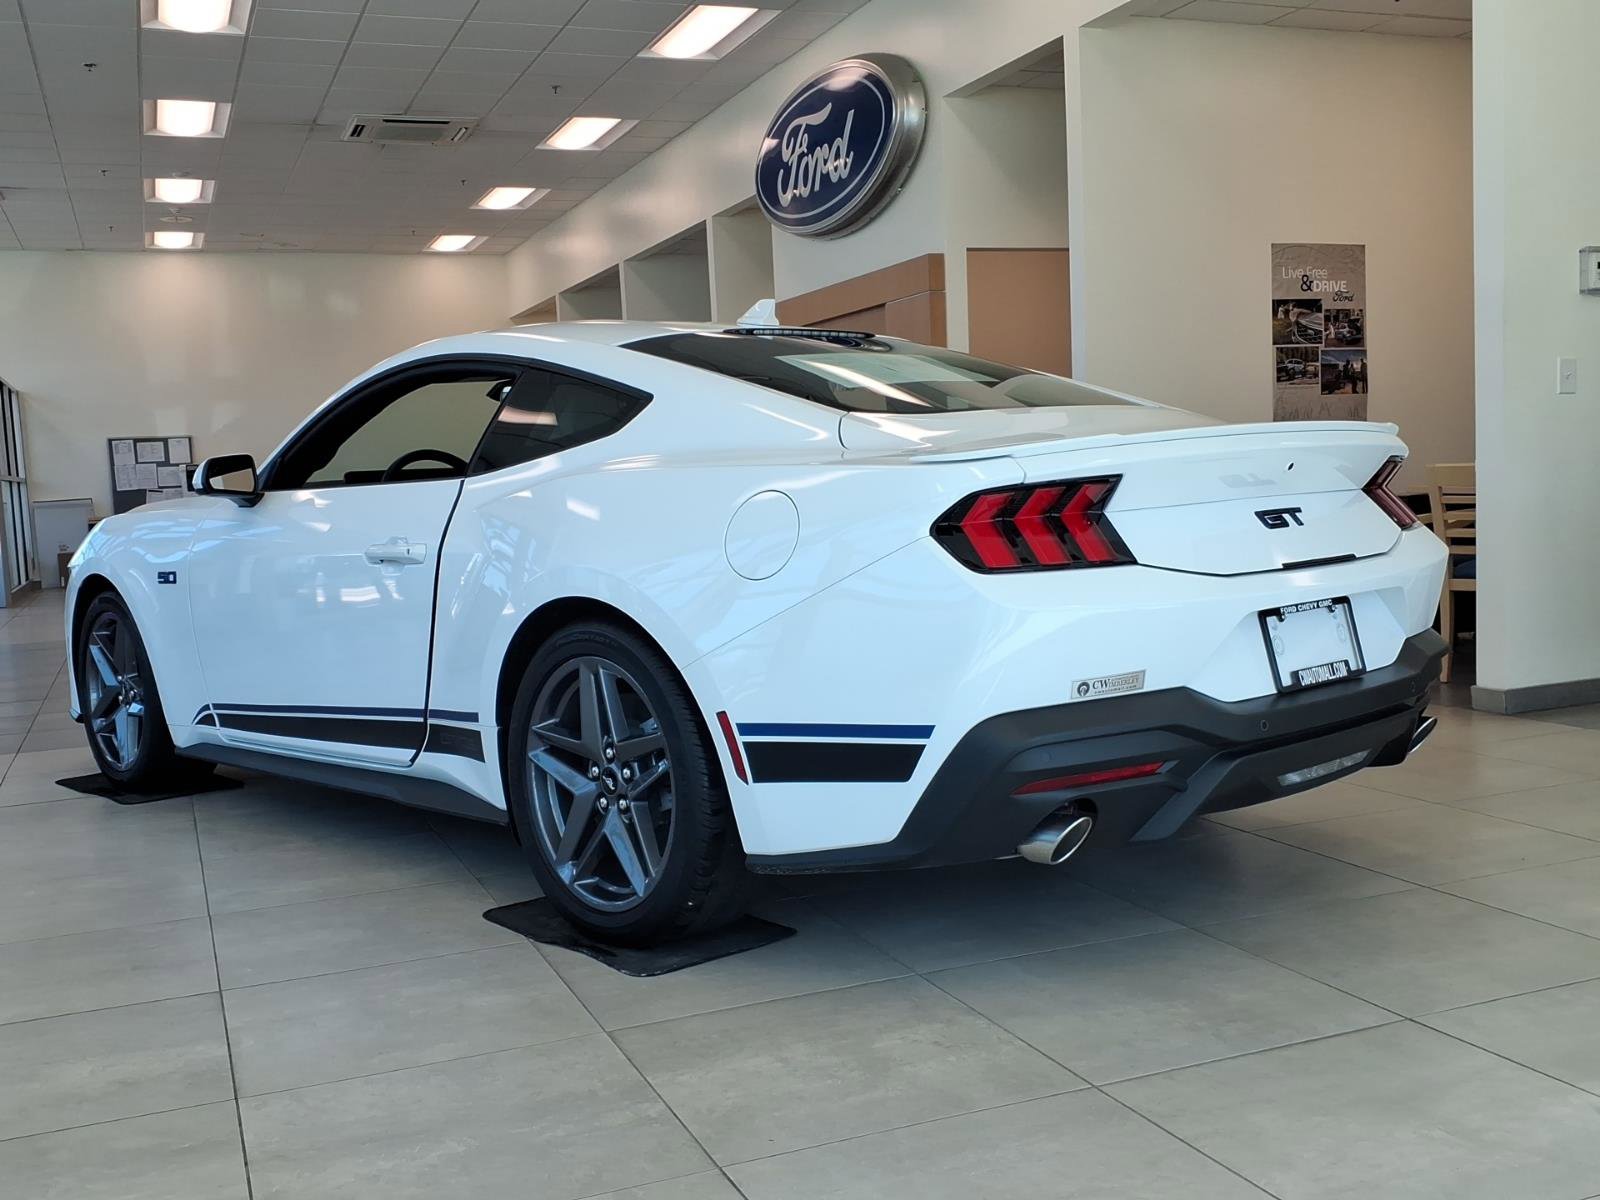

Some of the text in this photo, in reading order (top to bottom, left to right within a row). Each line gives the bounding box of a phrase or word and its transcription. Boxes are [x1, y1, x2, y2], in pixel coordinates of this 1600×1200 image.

[777, 102, 854, 207] Ford
[1282, 266, 1328, 279] Live Free
[1333, 290, 1354, 302] Ford
[1254, 507, 1304, 529] GT
[1280, 600, 1333, 614] FORD CHEVY GMC
